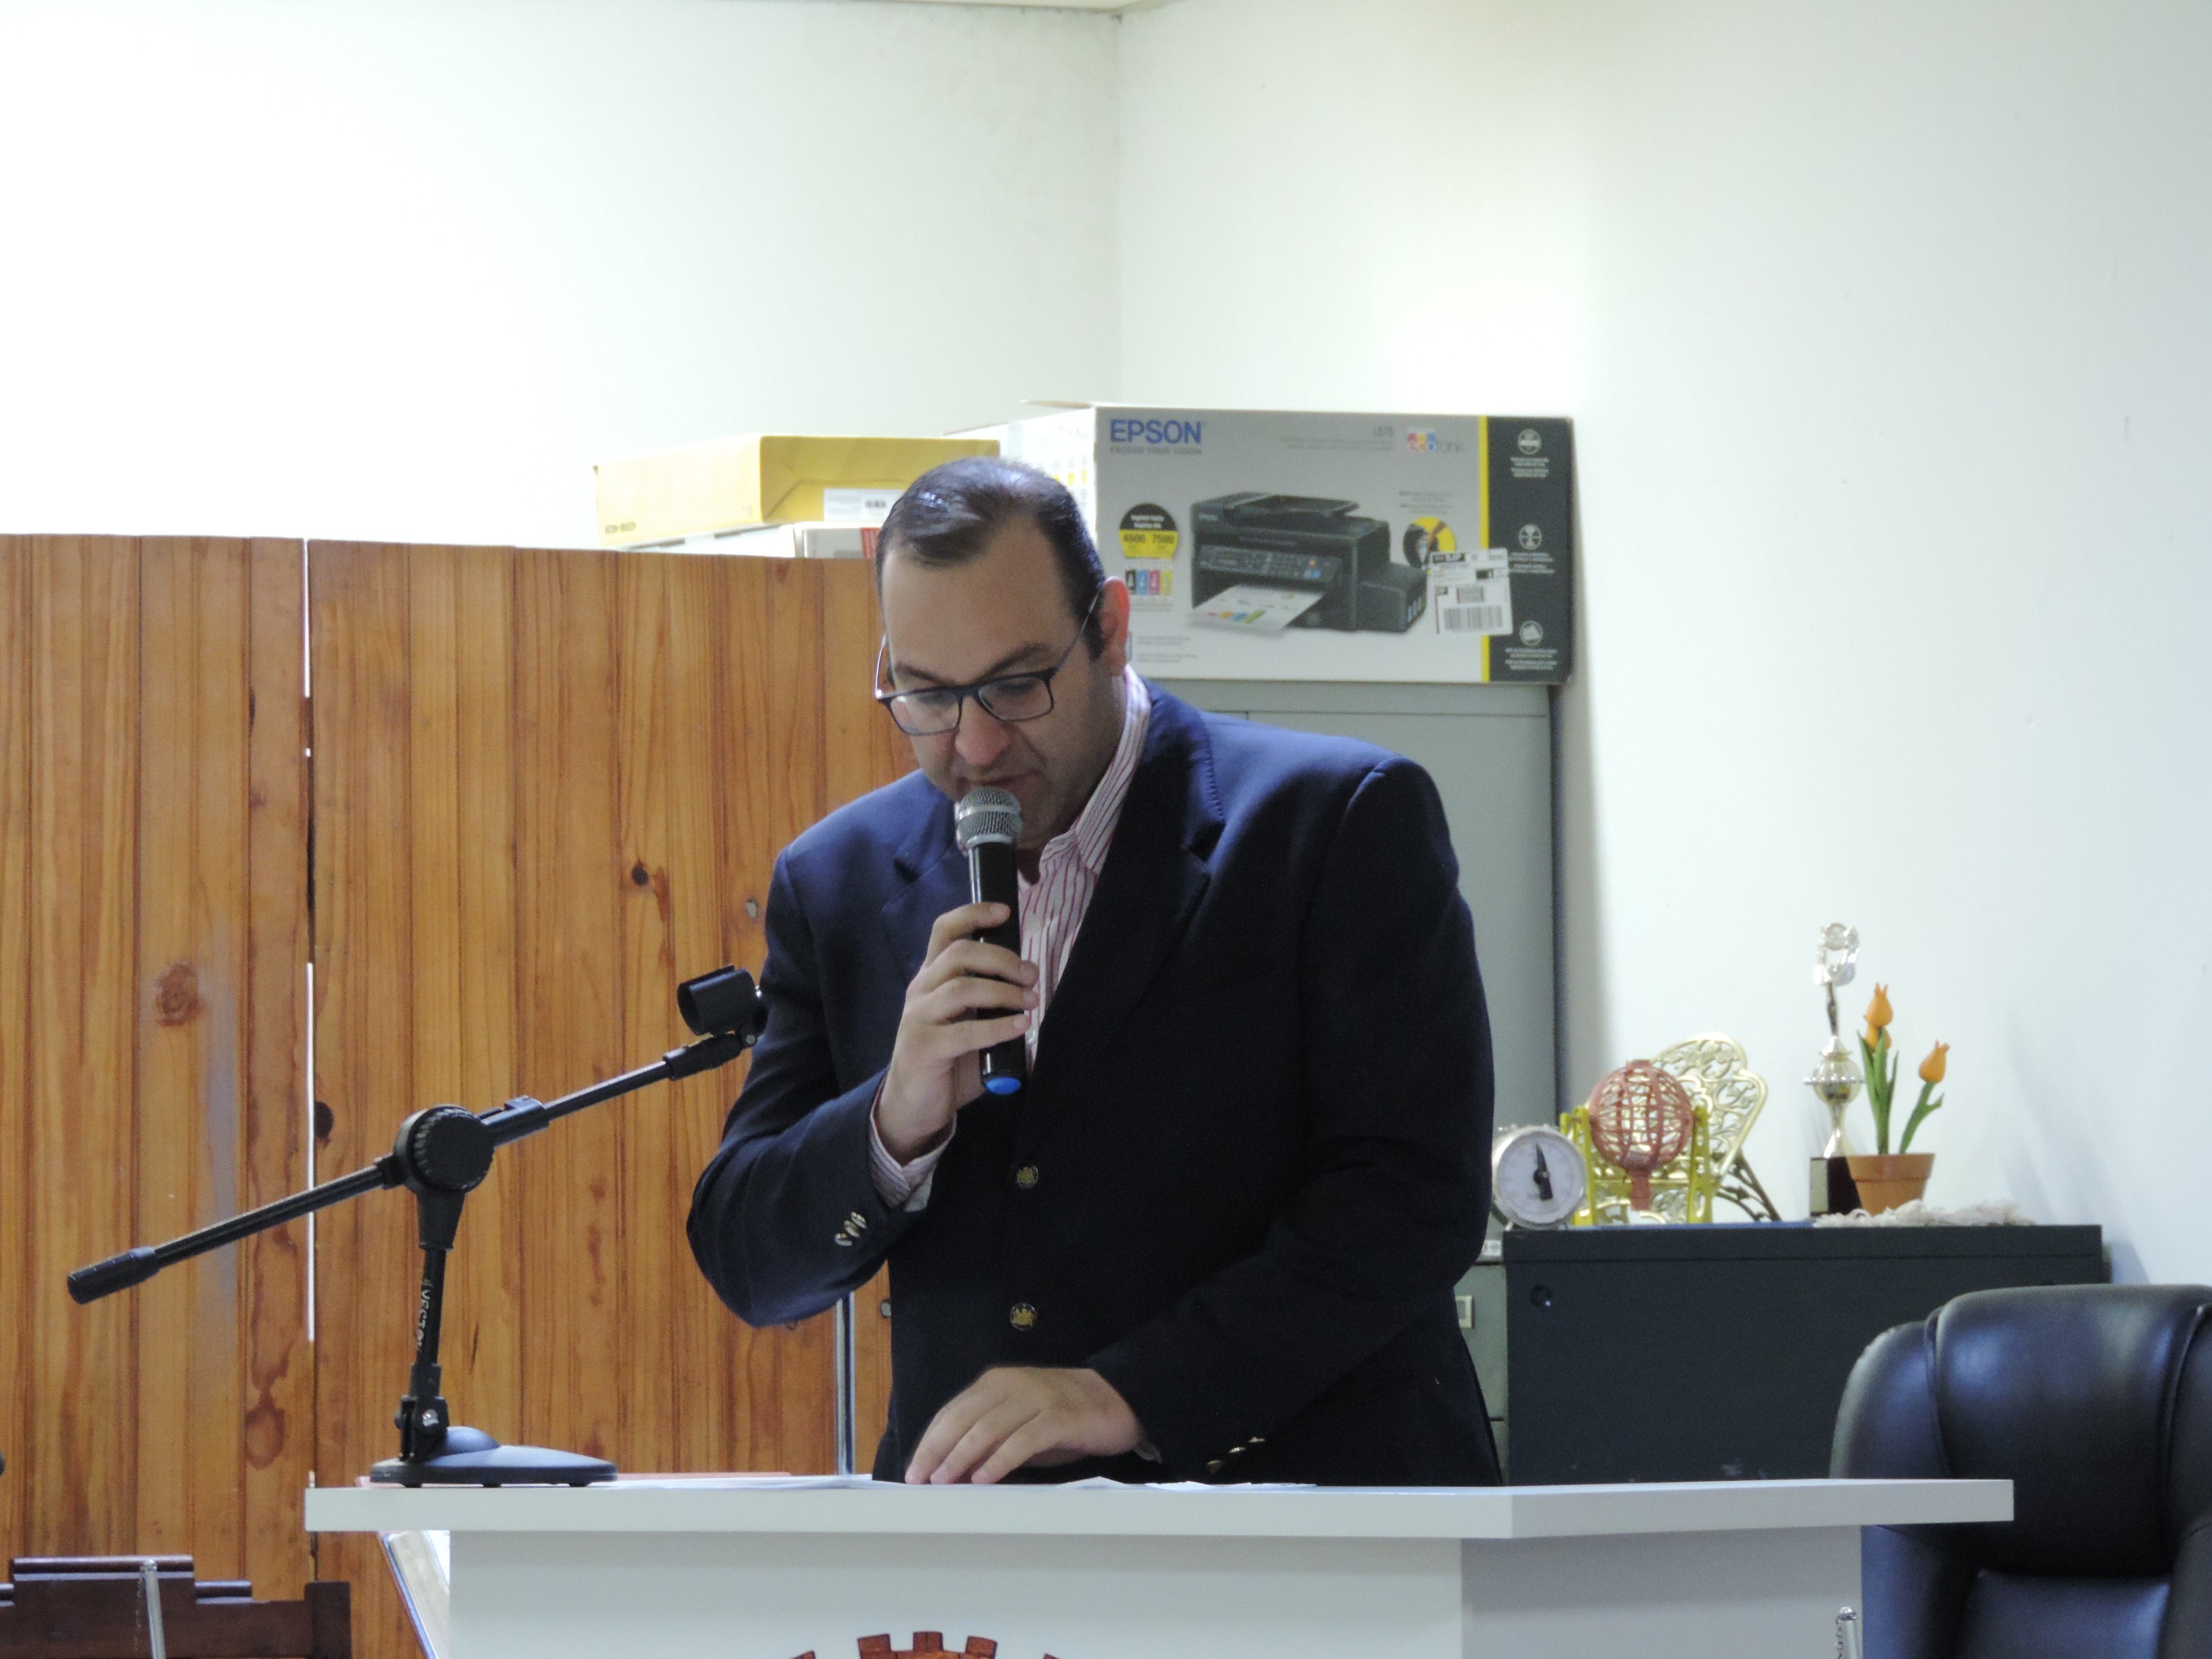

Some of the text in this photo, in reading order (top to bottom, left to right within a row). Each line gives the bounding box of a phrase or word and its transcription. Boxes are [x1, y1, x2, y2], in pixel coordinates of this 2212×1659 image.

[1109, 419, 1202, 444] EPSON
[1147, 447, 1171, 455] YOUR
[1173, 447, 1202, 455] VISION
